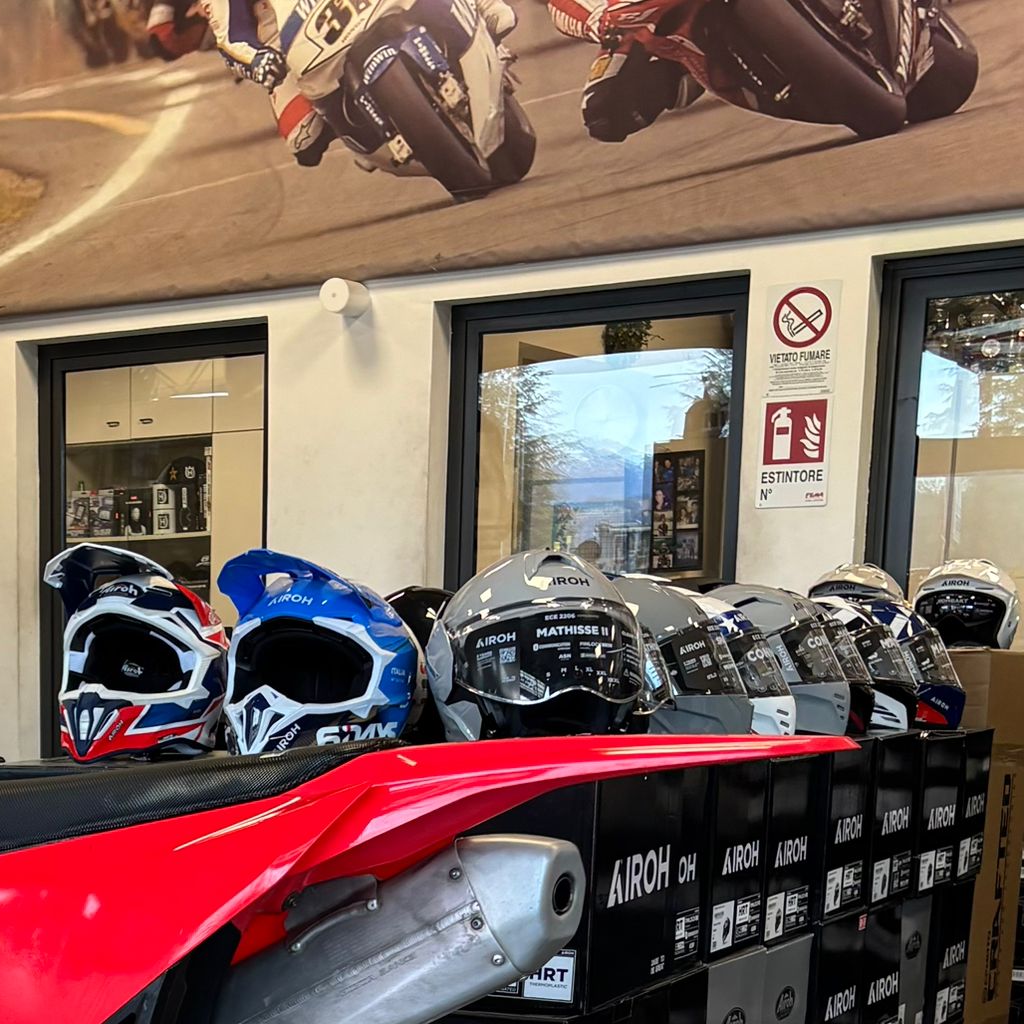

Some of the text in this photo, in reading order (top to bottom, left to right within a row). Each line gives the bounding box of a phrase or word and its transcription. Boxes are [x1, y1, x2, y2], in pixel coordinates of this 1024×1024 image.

[769, 348, 831, 364] VIETATO FUMARE
[761, 469, 823, 484] ESTINTORE
[99, 583, 138, 597] Airoh
[270, 594, 314, 606] AIROH
[829, 584, 856, 592] AIROH
[476, 632, 516, 649] AIROH
[536, 625, 600, 638] MATHISSE
[679, 640, 706, 655] AIROH
[776, 644, 795, 673] AIROH
[276, 723, 301, 751] IROH
[927, 804, 956, 830] AIROH
[964, 792, 985, 818] AIROH
[834, 814, 863, 845] AIROH
[881, 806, 910, 836] AIROH
[721, 840, 760, 876] AIROH
[774, 836, 808, 869] AIROH
[606, 844, 671, 909] AIROH
[943, 940, 966, 969] AIROH
[529, 967, 569, 982] HRT
[529, 981, 568, 989] THERMOPLASTIC
[867, 970, 899, 1005] AIROH
[824, 985, 857, 1021] AIROH
